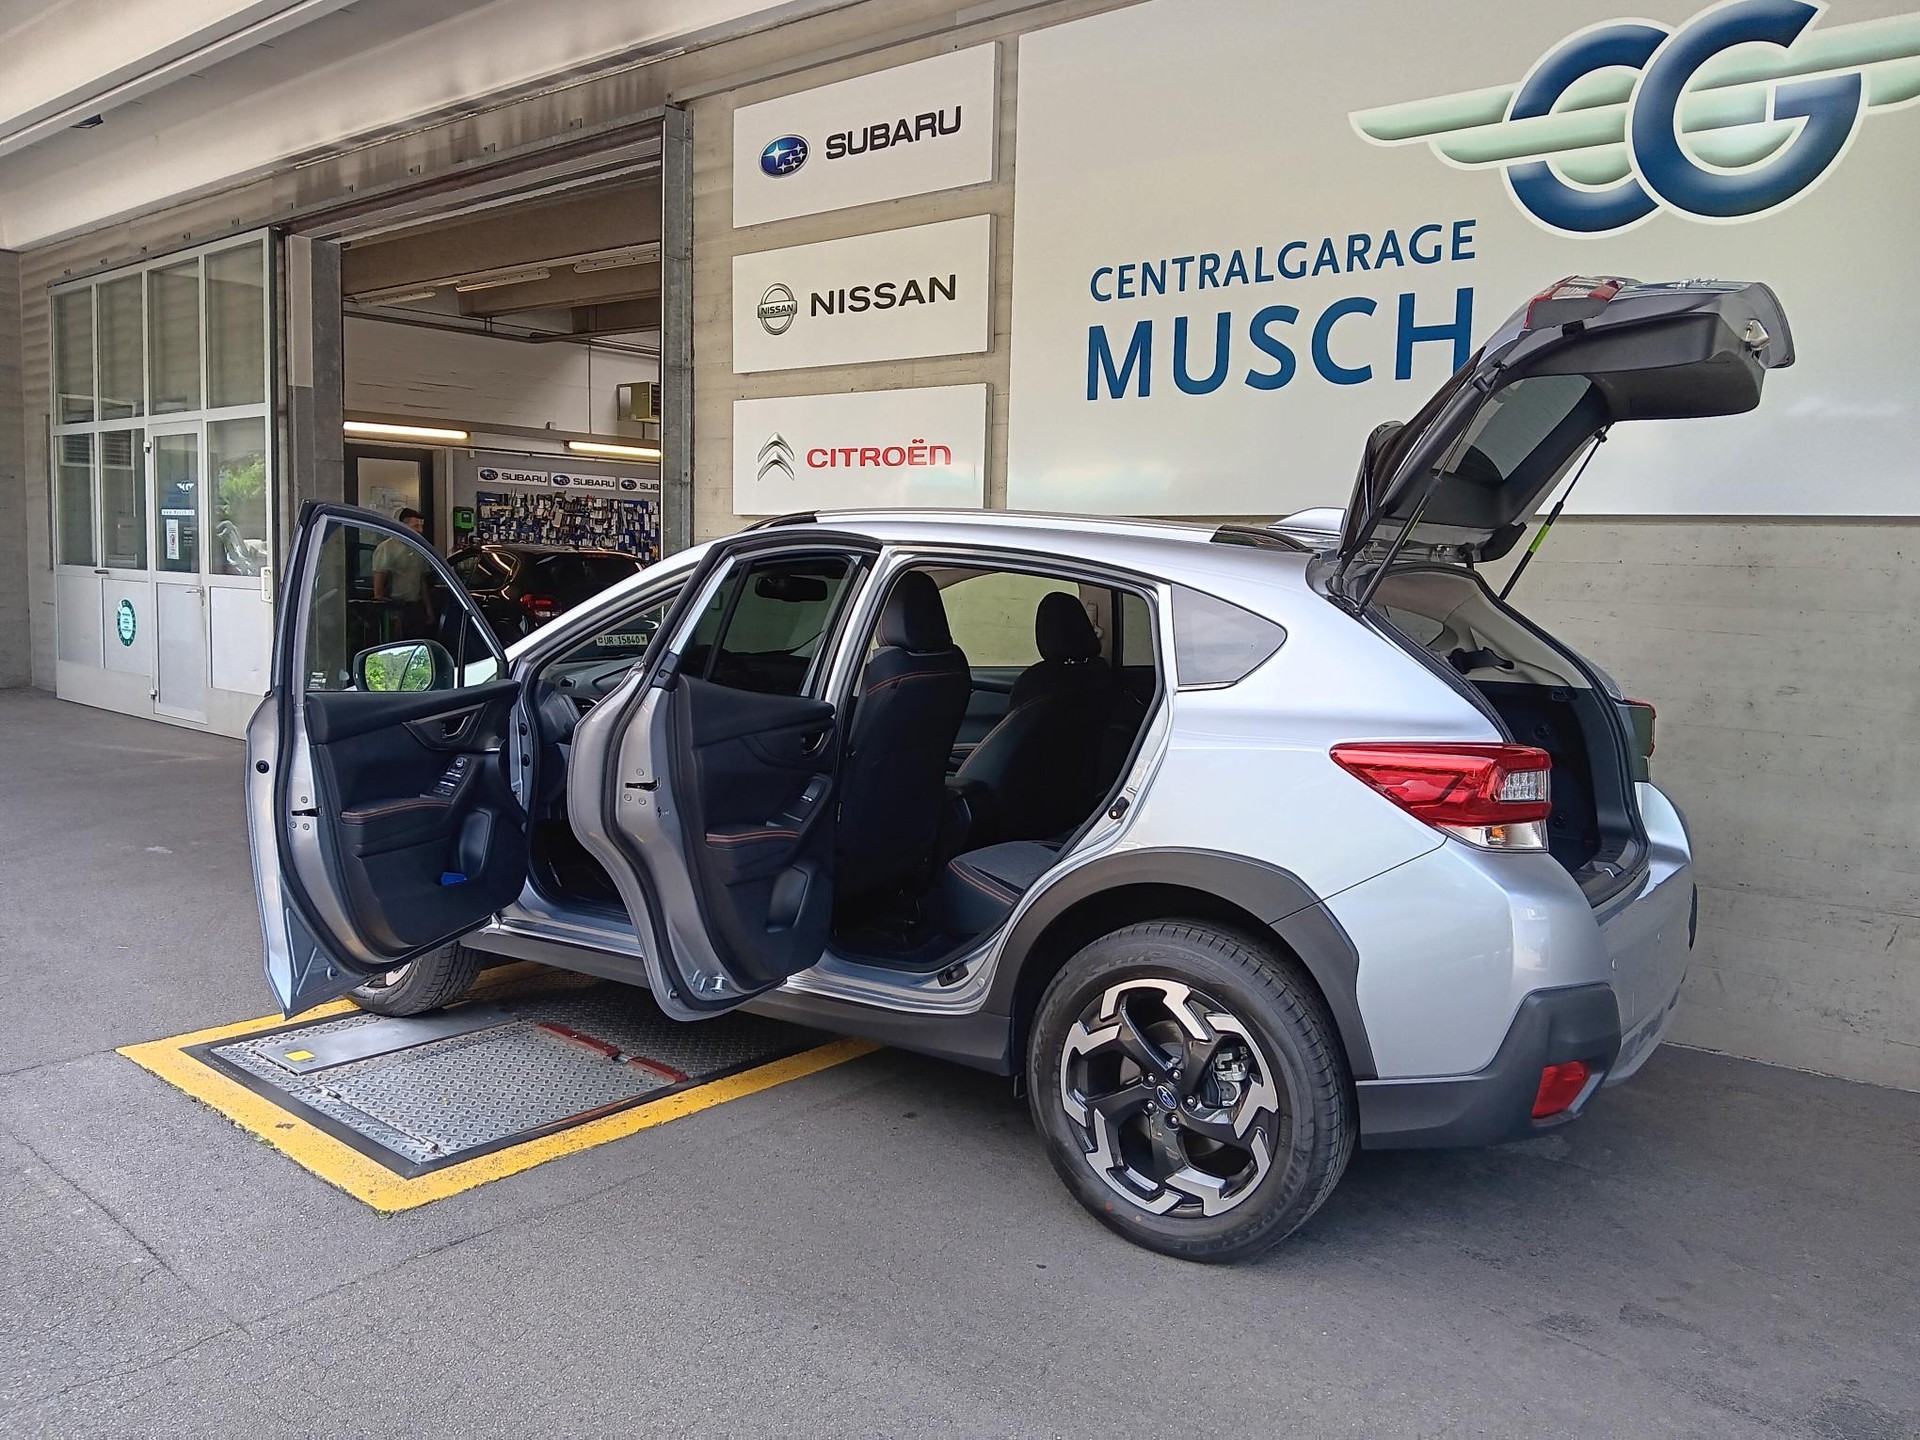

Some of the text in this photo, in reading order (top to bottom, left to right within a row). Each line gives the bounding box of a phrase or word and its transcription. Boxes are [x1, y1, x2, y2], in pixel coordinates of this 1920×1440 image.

[825, 105, 962, 160] SUBARU
[1089, 219, 1477, 302] CENTRALGARAGE
[760, 303, 795, 315] NISSAN
[810, 274, 957, 317] NISSAN
[1087, 286, 1474, 401] MUSCH
[806, 438, 952, 468] CITROËN
[501, 472, 547, 483] SUBARU
[573, 477, 615, 488] SUBARU
